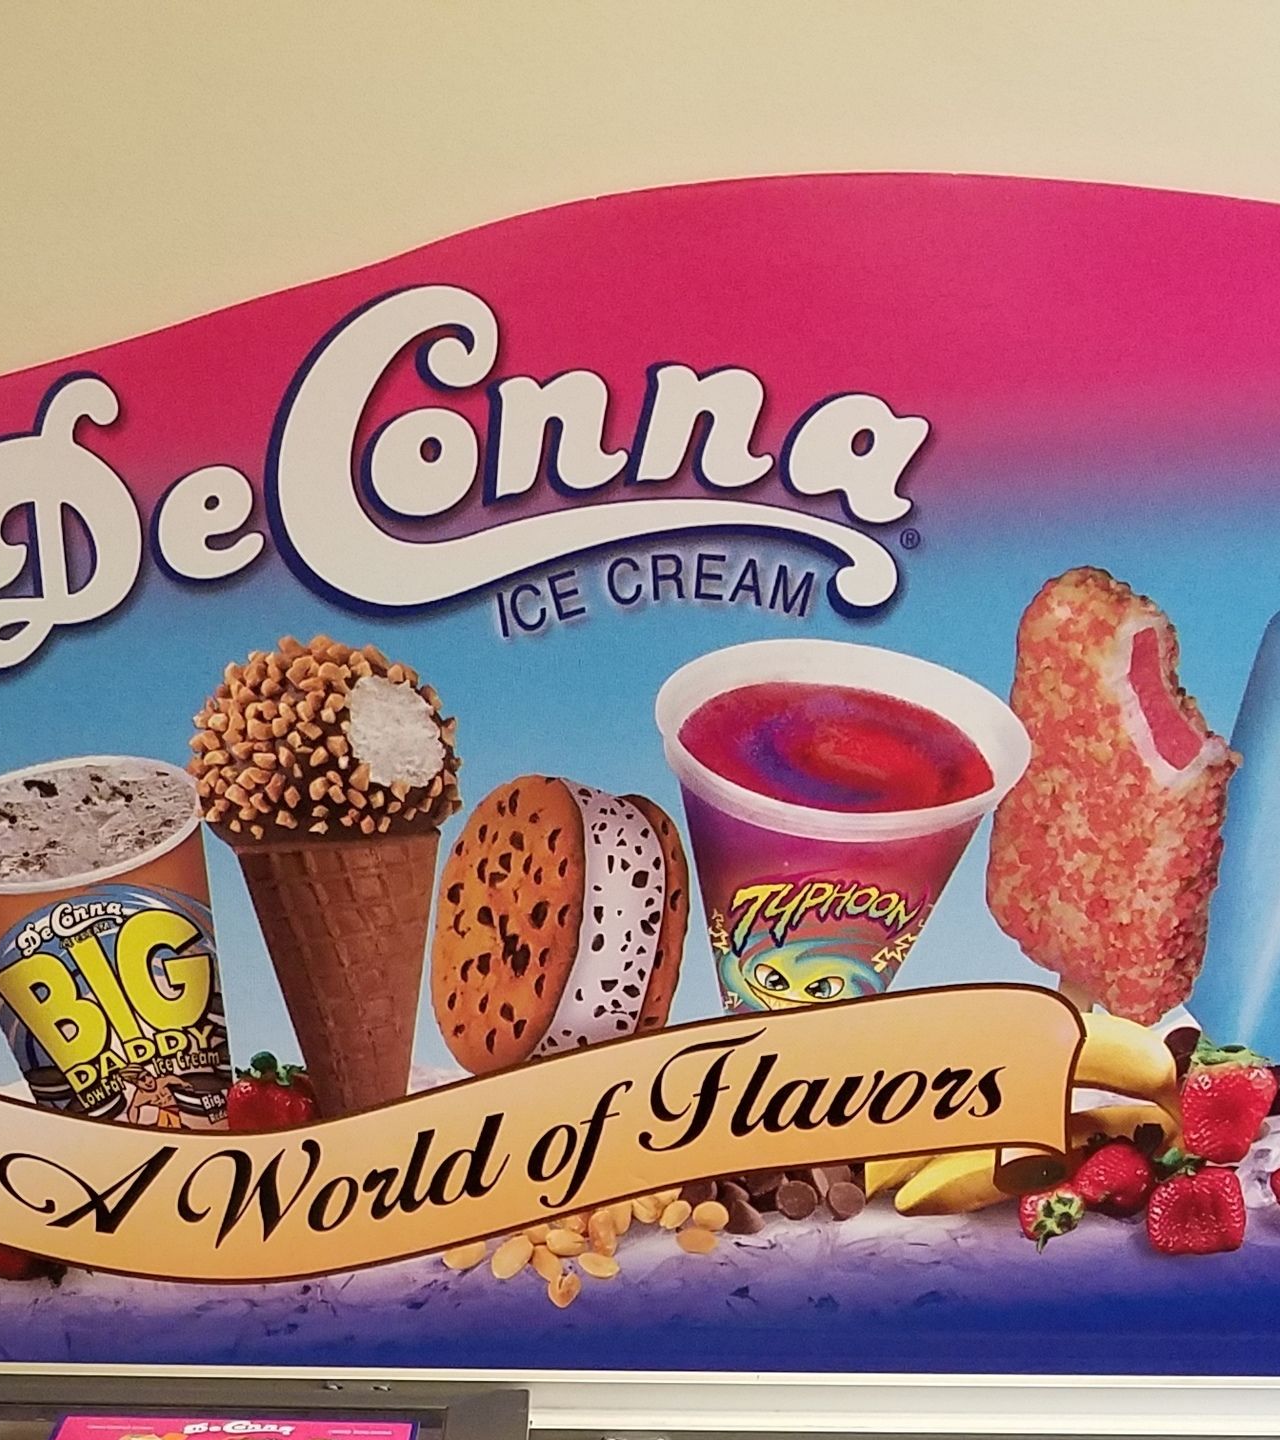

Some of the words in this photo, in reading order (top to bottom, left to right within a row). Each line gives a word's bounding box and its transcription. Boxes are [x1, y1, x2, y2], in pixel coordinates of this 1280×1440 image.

[496, 581, 590, 639] ICE
[607, 553, 817, 620] CREAM
[730, 881, 928, 949] TYPHOON
[64, 1023, 214, 1094] DADDY
[176, 1049, 221, 1070] Cream
[76, 1086, 102, 1110] Low
[178, 1112, 511, 1250] World
[526, 1080, 634, 1210] of
[637, 1026, 1007, 1153] Flavors
